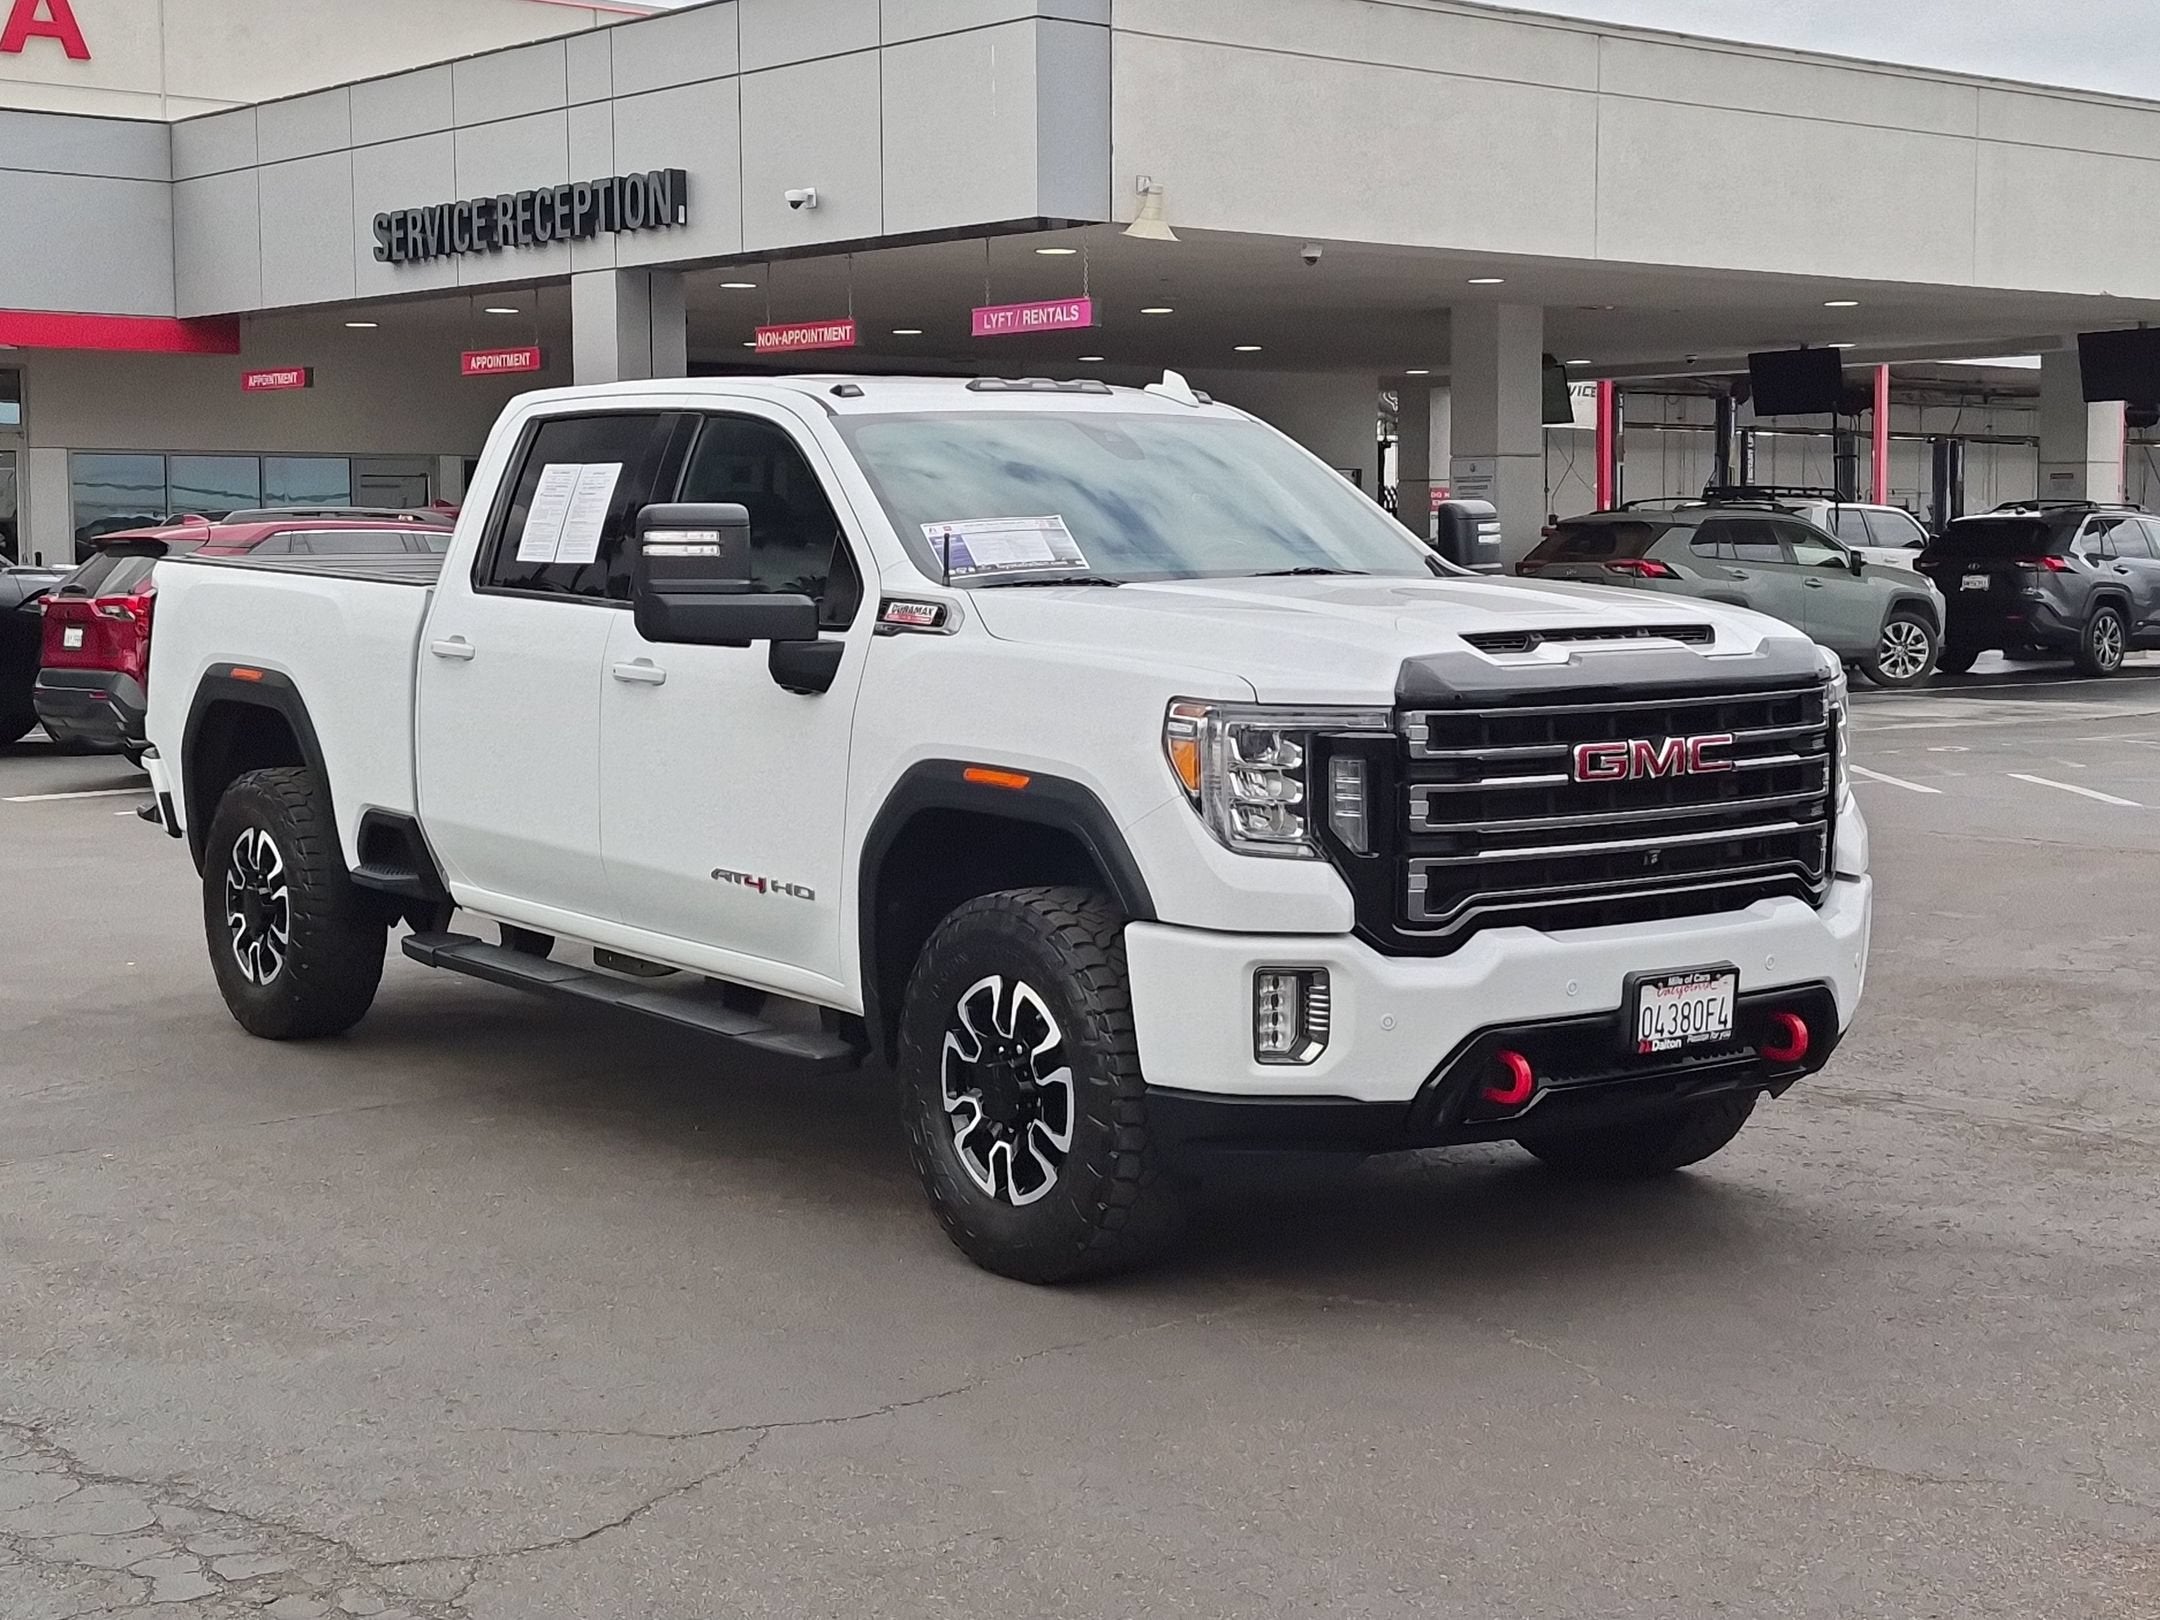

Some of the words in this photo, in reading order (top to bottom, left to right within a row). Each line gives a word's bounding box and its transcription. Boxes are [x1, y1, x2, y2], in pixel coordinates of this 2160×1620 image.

[373, 198, 488, 262] SERVICE
[983, 311, 1013, 330] LYFT
[1013, 309, 1021, 328] /
[1022, 305, 1080, 327] RENTALS
[757, 326, 852, 348] NON-APPOINTMENT
[470, 353, 531, 370] APPOINTMENT
[248, 371, 298, 388] APPOINTMENT
[891, 604, 934, 617] DURAMAX
[1573, 734, 1733, 782] GMC
[711, 868, 767, 894] AT4
[771, 880, 815, 900] HD
[1642, 996, 1728, 1039] 04380F4
[1652, 1038, 1682, 1052] Dalton
